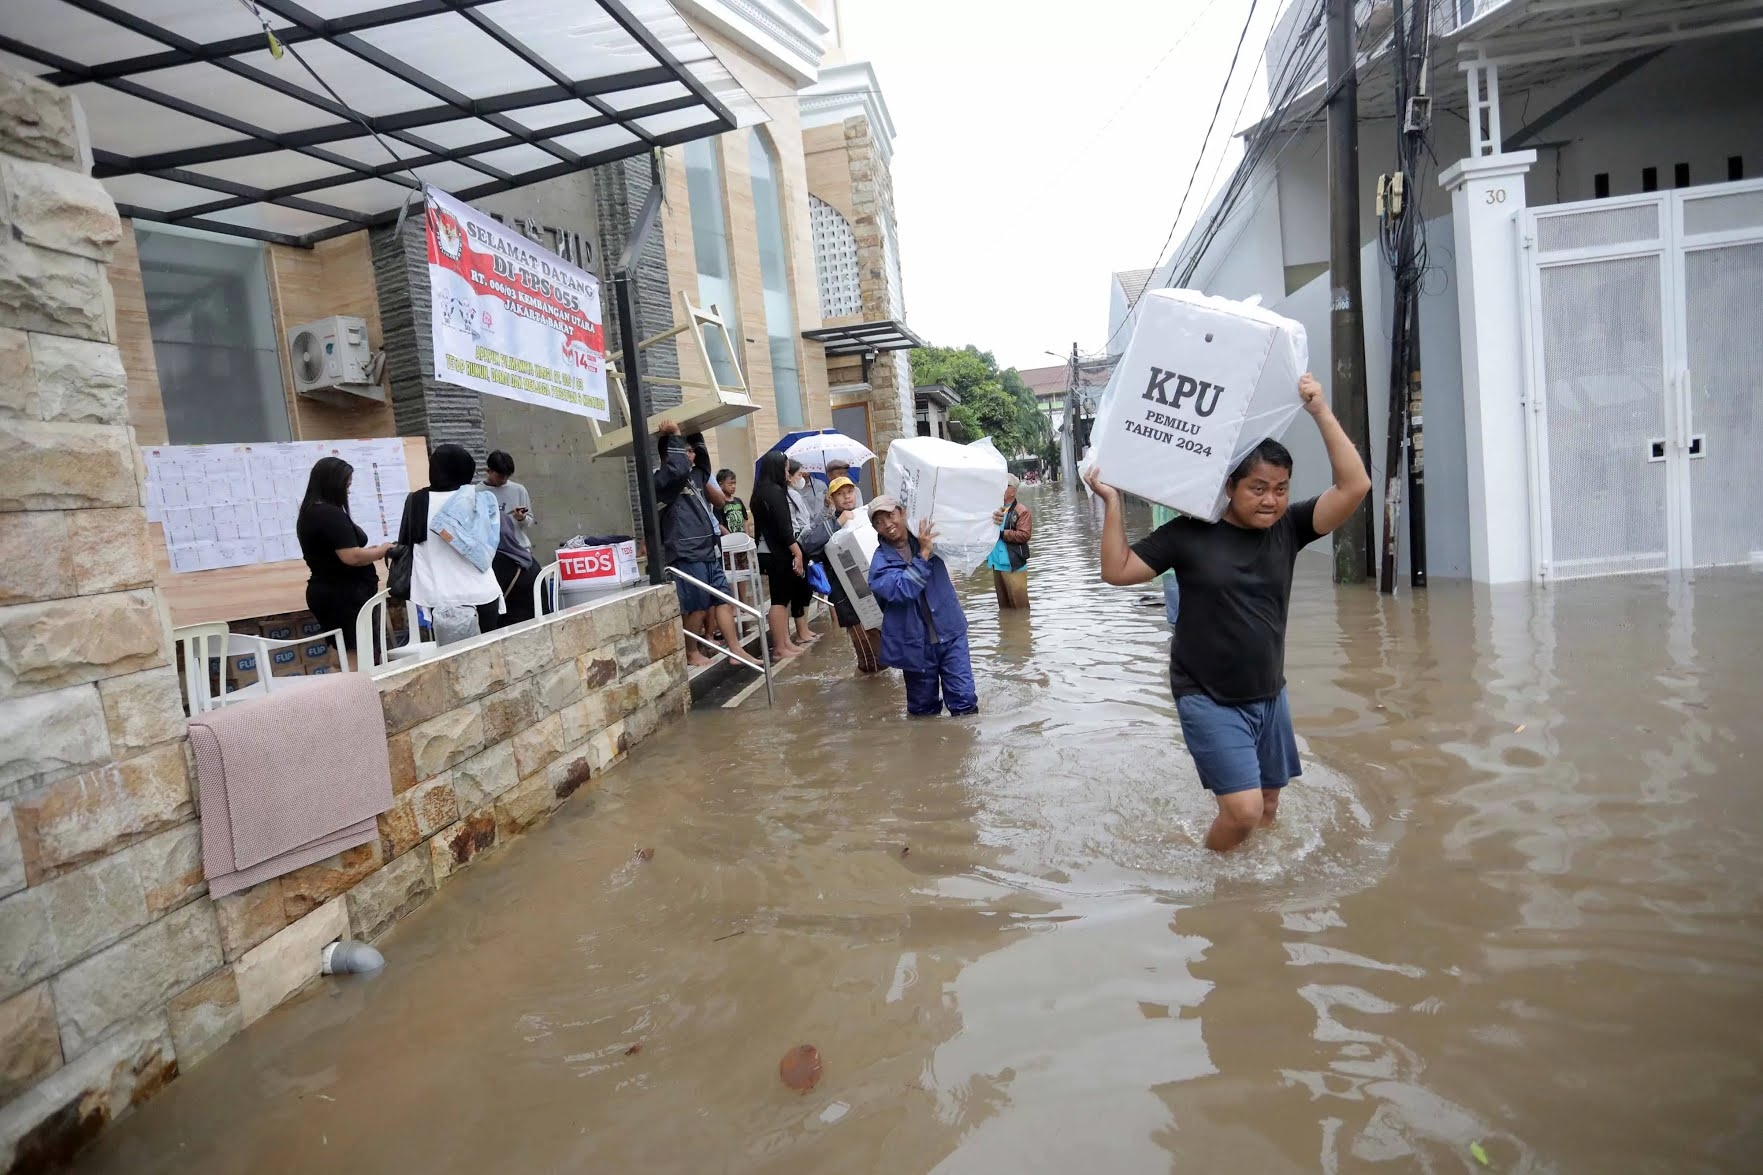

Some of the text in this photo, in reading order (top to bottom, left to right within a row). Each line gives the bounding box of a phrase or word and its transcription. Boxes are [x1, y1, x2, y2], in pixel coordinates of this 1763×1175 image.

[1486, 189, 1506, 205] 30
[466, 221, 538, 270] SELAMAT
[541, 261, 594, 298] DATANG
[494, 254, 580, 312] DI TPS 055
[471, 270, 595, 333] RT. 006/03 KEMBANGAN UTARA
[504, 300, 574, 335] JAKARTA BARAT
[574, 350, 588, 370] 14
[1142, 366, 1225, 418] KPU
[1145, 410, 1201, 435] PEMILU
[1125, 420, 1212, 457] TAHUN 2024
[561, 551, 612, 575] TED'S
[271, 629, 290, 639] FLIP
[304, 623, 321, 634] FLIP
[275, 652, 294, 664] FLIP
[308, 646, 326, 657] FLIP
